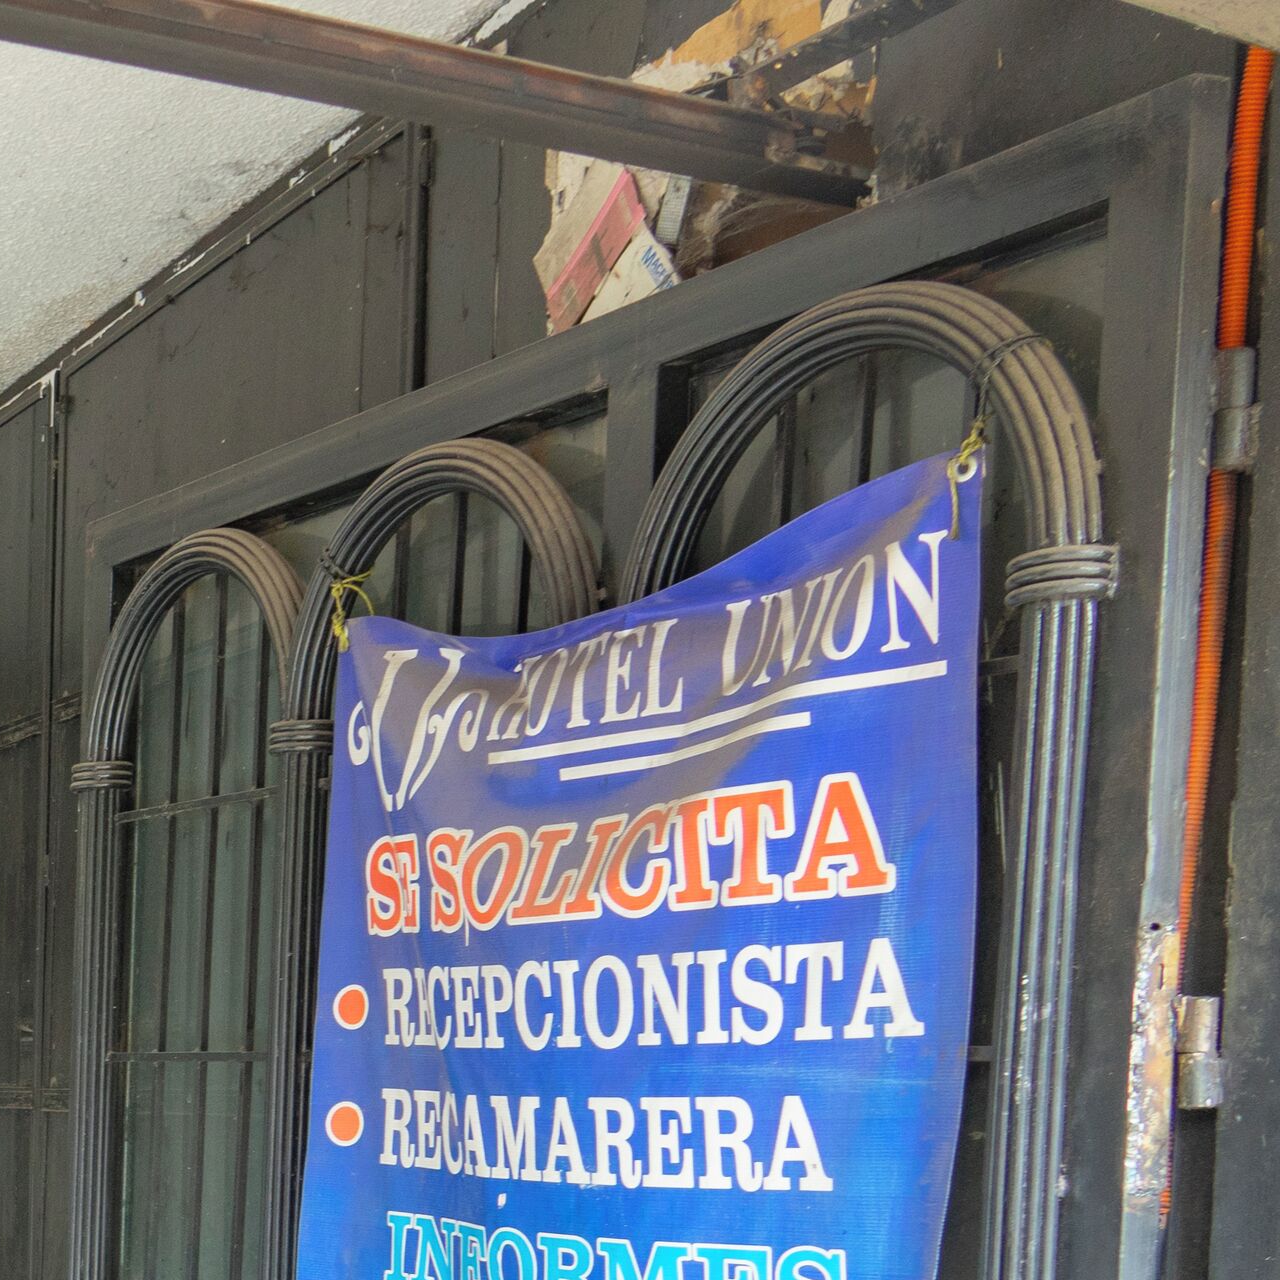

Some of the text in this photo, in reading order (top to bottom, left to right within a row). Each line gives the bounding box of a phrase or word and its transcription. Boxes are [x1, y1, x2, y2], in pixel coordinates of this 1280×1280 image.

[486, 617, 684, 742] HOTEL
[722, 530, 948, 697] UNION
[426, 772, 895, 935] SOLICITA
[382, 936, 926, 1051] RECEPCIONISTA
[378, 1086, 834, 1193] RECAMARERA
